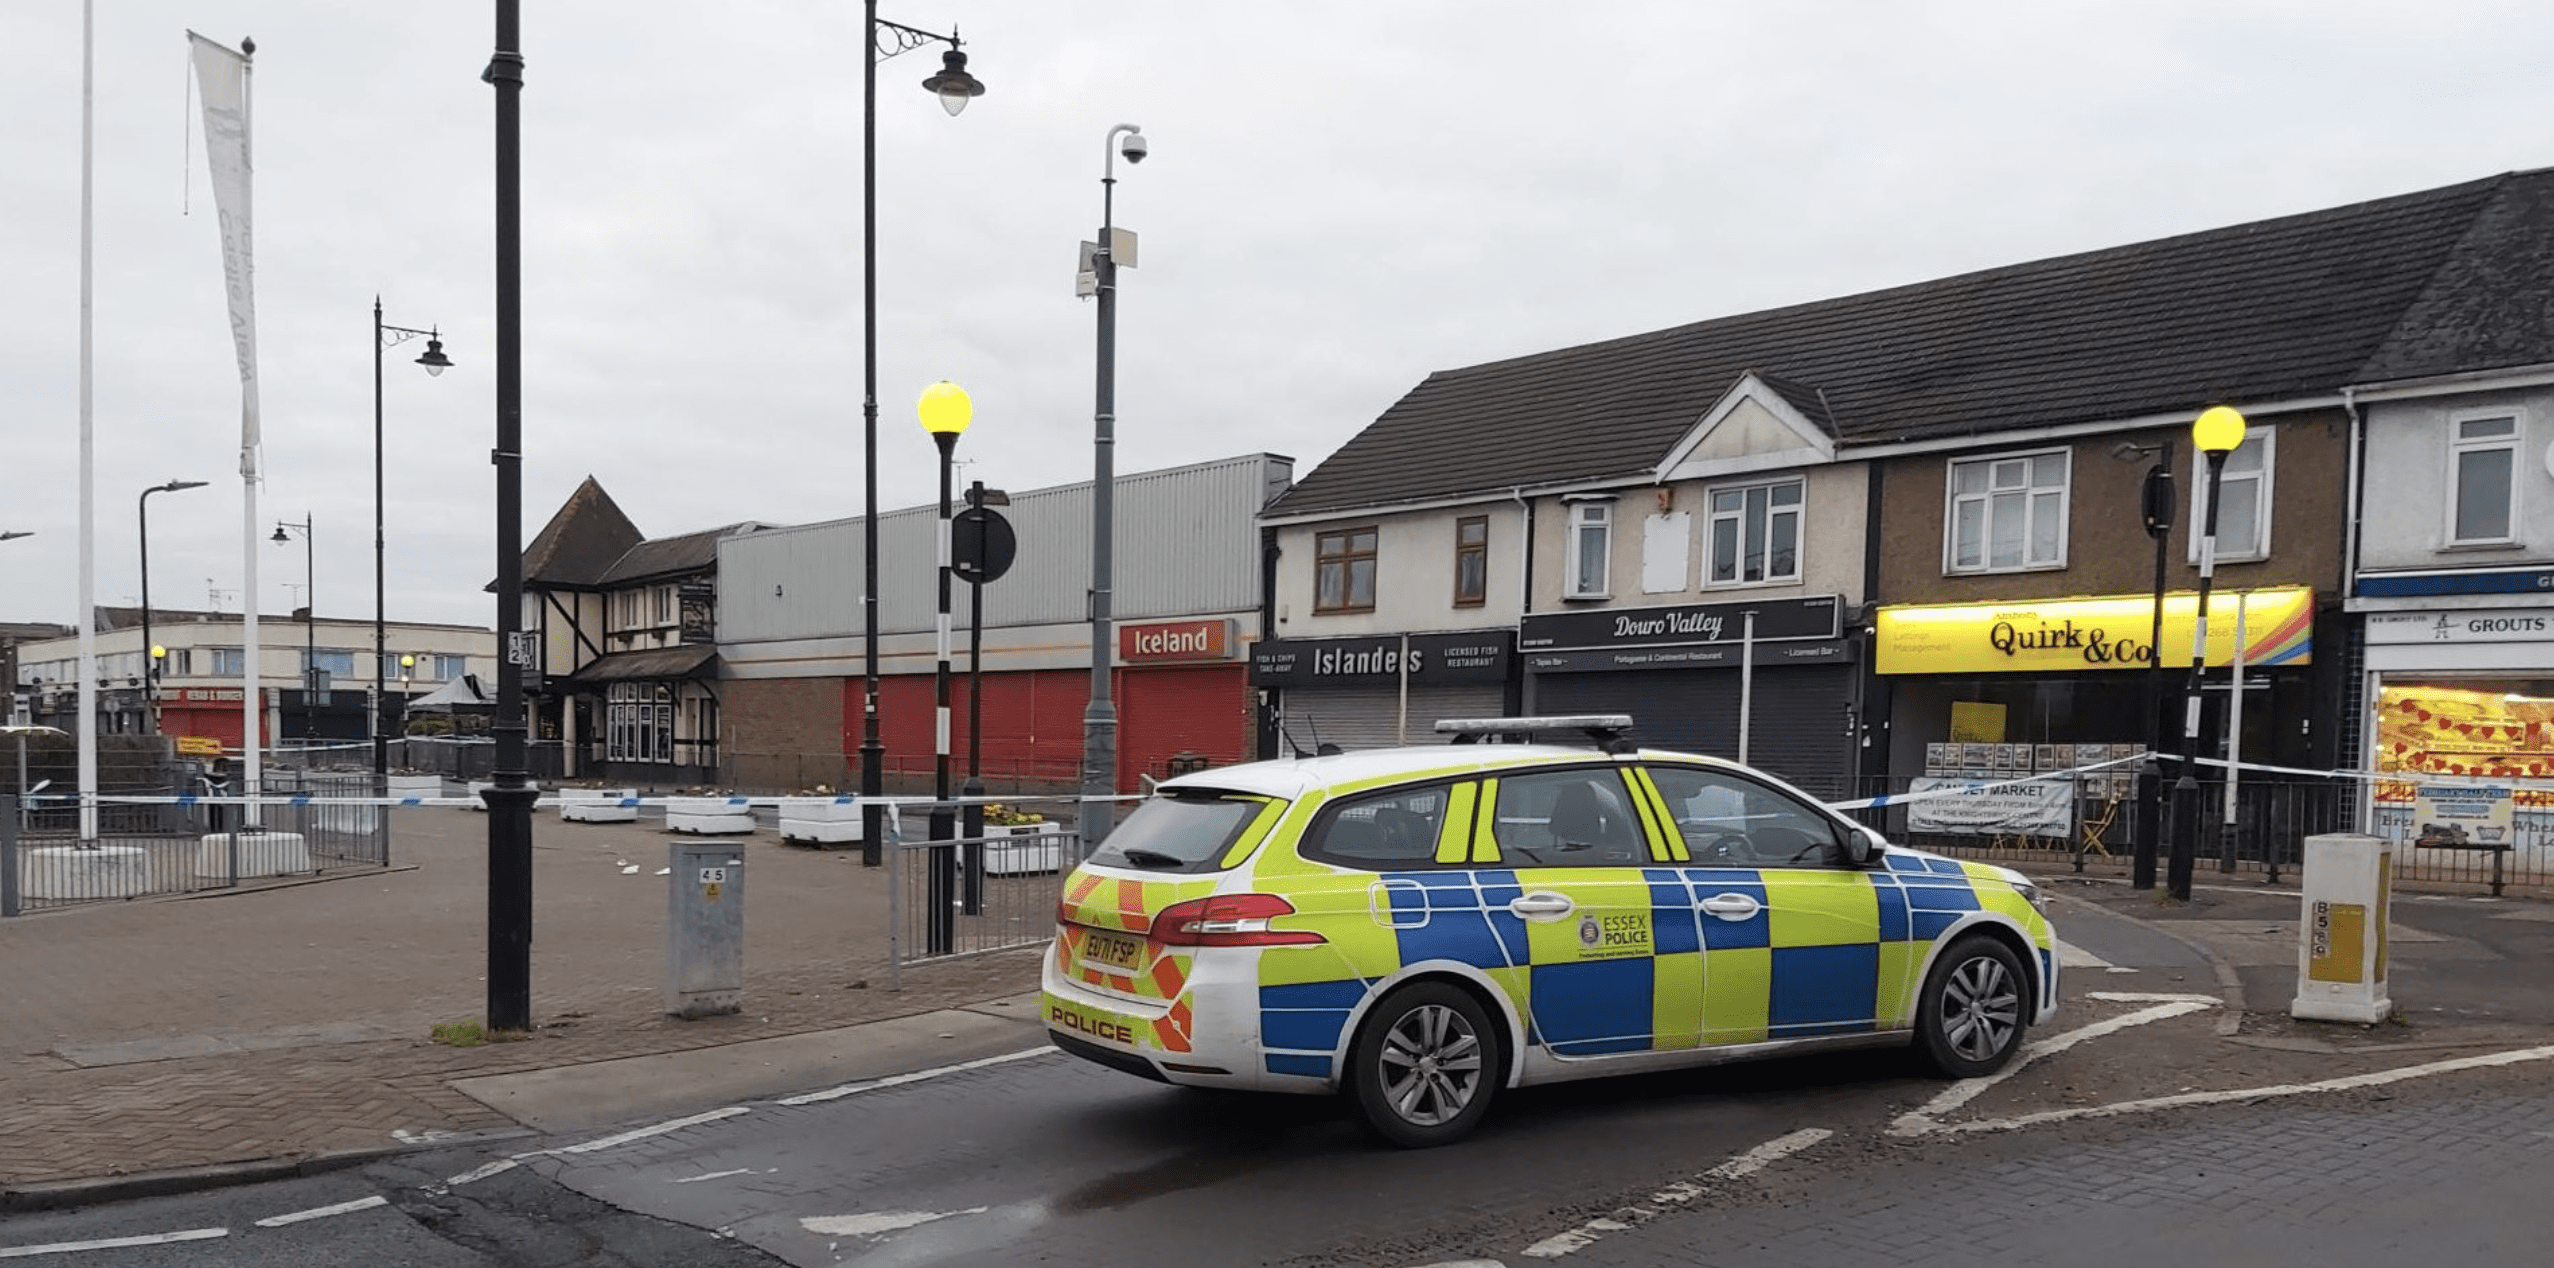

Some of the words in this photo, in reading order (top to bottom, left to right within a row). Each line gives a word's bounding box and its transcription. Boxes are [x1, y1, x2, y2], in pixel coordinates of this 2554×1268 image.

[1614, 615, 1665, 637] Douro
[1666, 611, 1723, 640] Valley
[2467, 617, 2546, 633] GROUTS
[1135, 626, 1208, 654] Iceland
[1990, 619, 2084, 657] Quirk
[1314, 646, 1422, 675] Islandes
[1444, 647, 1479, 657] LICENSED
[1480, 646, 1498, 655] FISH
[1447, 657, 1494, 668] RESTAURANT
[1935, 783, 1985, 795] CAVEY
[1990, 785, 2044, 797] MARKET
[1605, 915, 1646, 931] ESSEX
[1087, 935, 1112, 960] EU71
[1111, 939, 1136, 963] FSP
[1606, 931, 1648, 945] POLICE
[1052, 1006, 1133, 1044] POLICE
